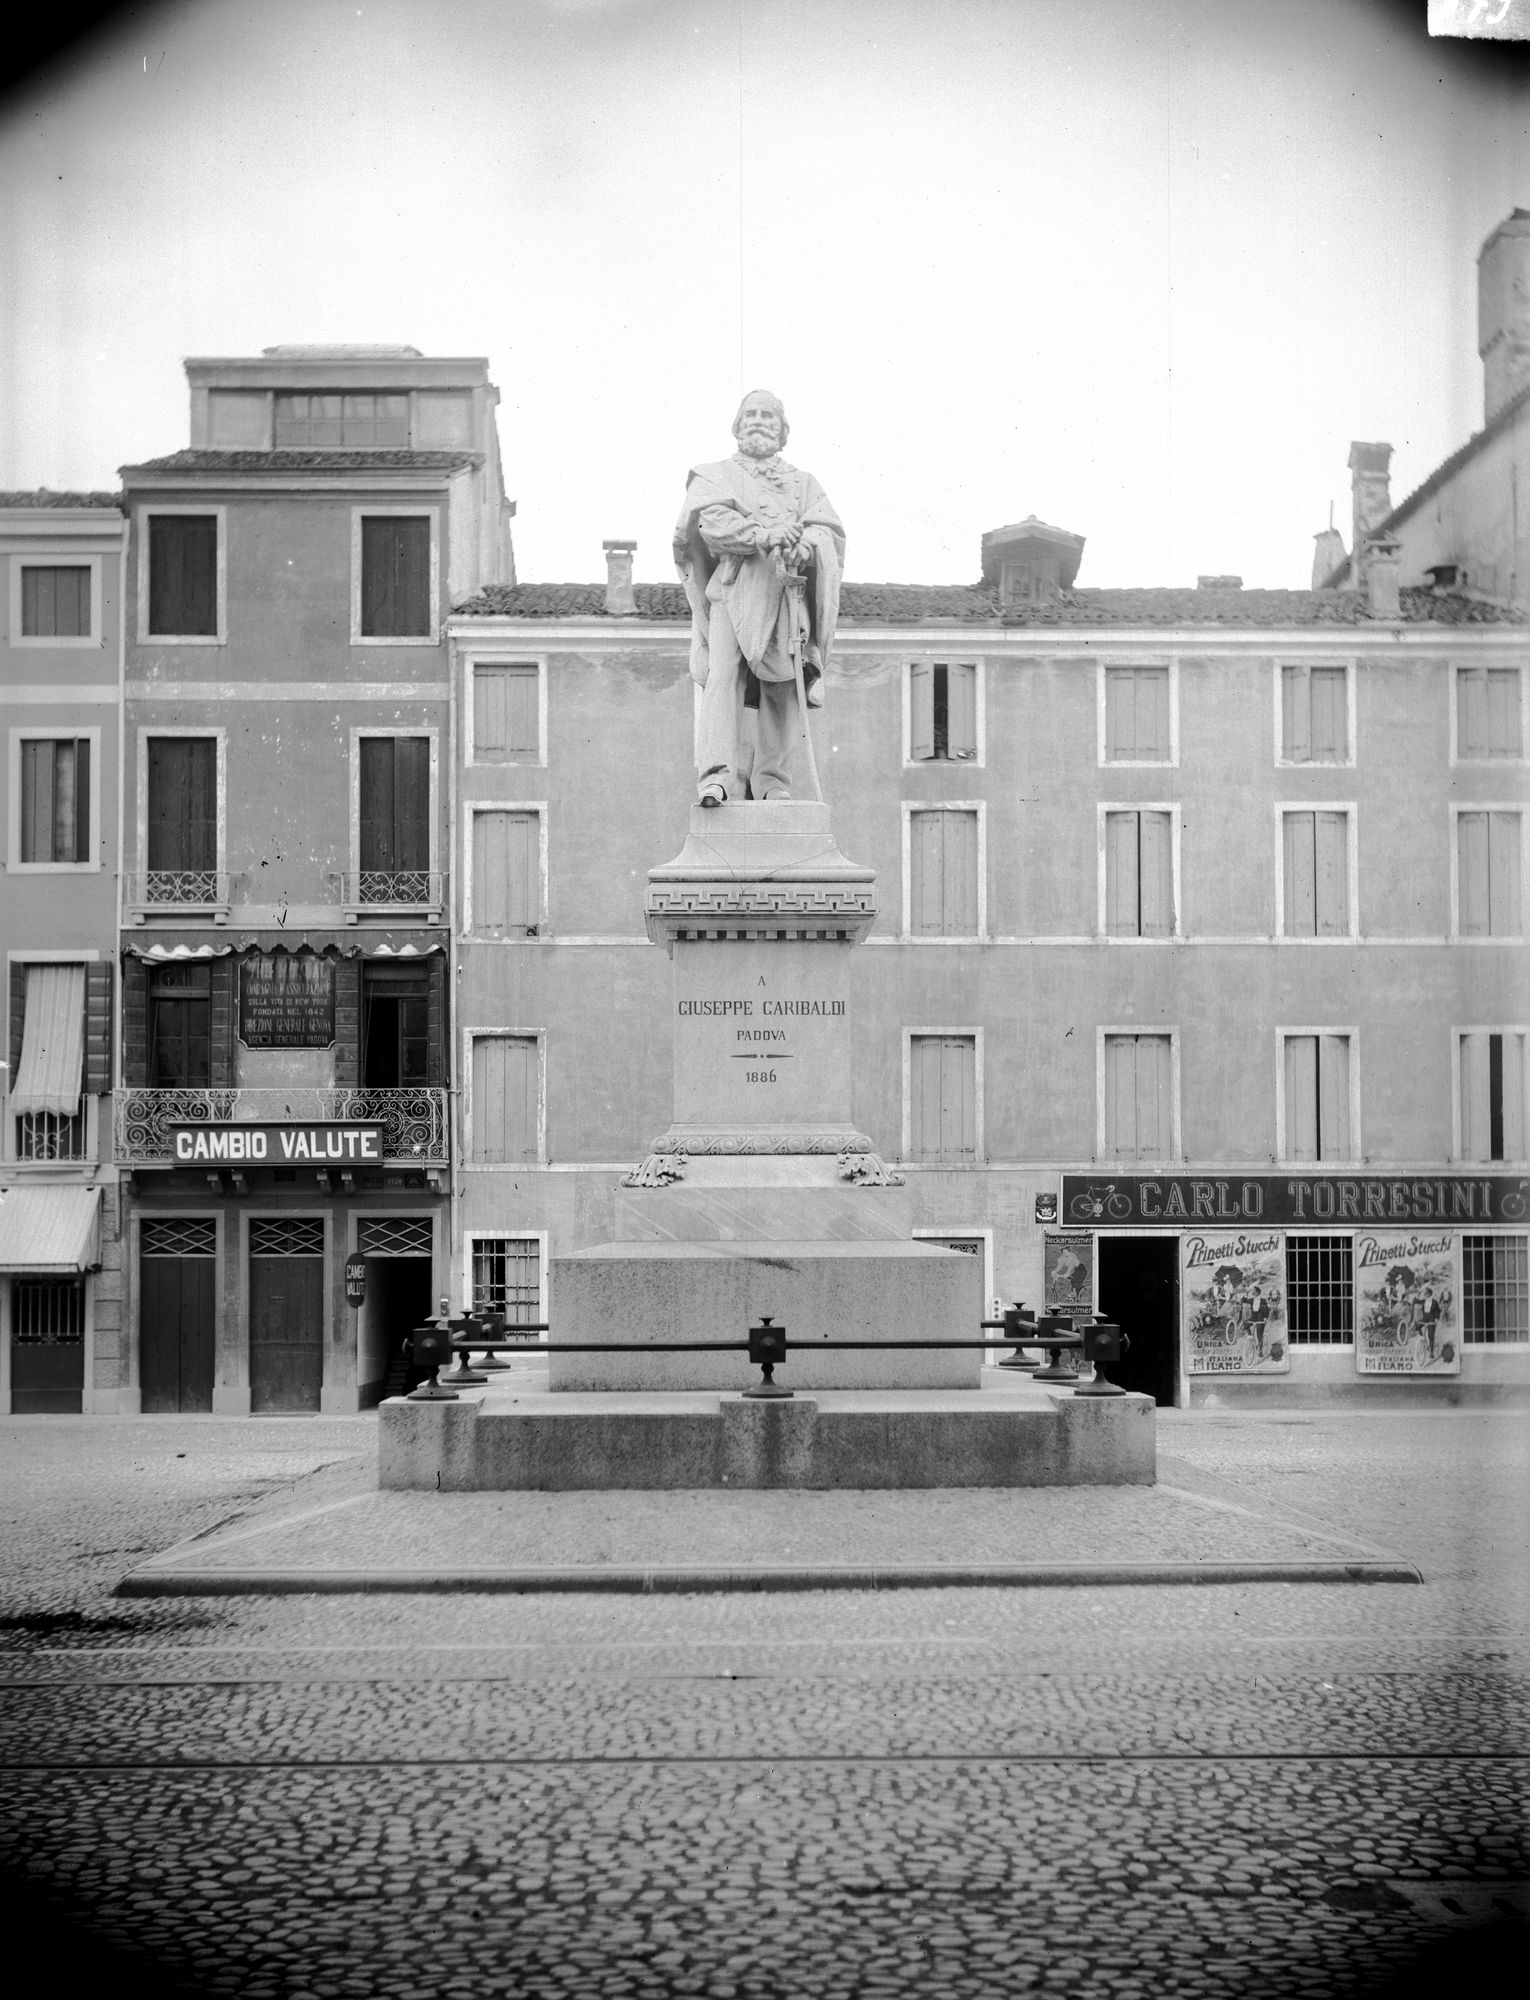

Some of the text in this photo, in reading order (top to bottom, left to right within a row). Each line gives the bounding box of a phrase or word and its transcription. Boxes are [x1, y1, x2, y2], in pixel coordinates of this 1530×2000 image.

[757, 975, 767, 986] A
[248, 998, 328, 1006] SULLA VITA DI NEW YORK
[678, 1001, 846, 1016] GIUSEPPE GARIBALDI
[252, 1008, 325, 1016] FONDATA NEL 1842
[274, 1035, 305, 1044] GENERALE
[307, 1035, 329, 1044] PADOVA
[737, 1030, 787, 1041] PADOVA
[746, 1068, 777, 1083] 1886
[176, 1131, 379, 1159] CAMBIO VALUTE
[1139, 1181, 1493, 1218] CARLO TORRESINI
[1045, 1236, 1093, 1244] Neckarsulmer
[1186, 1236, 1280, 1269] Prinetti Stucchi
[1358, 1236, 1452, 1268] Prinetti Stucchi
[346, 1265, 366, 1279] CAMB
[346, 1281, 366, 1296] VALUT
[1193, 1357, 1242, 1371] MILANO
[1365, 1358, 1413, 1371] MILANO
